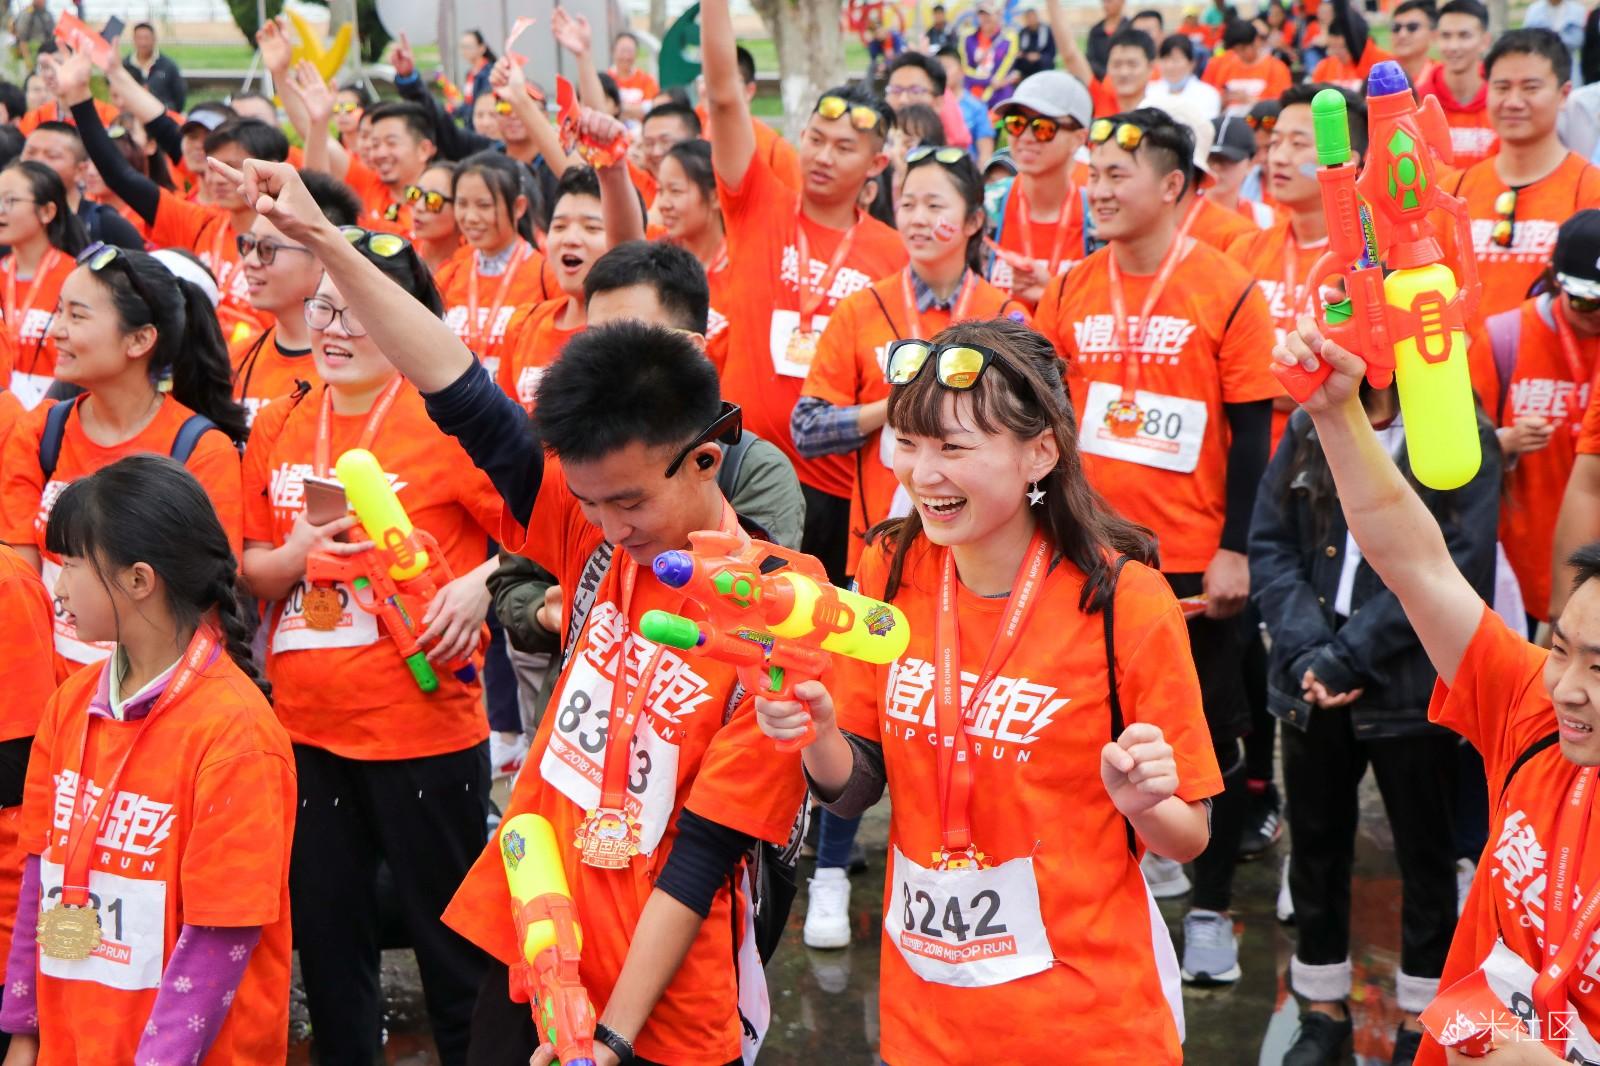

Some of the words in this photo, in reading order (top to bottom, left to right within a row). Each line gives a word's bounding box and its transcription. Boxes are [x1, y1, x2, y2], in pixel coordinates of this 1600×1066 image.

[1144, 408, 1182, 439] 80
[944, 690, 952, 705] 2018
[558, 689, 652, 794] 833
[975, 742, 1031, 763] RUN
[564, 749, 590, 772] 2018
[101, 852, 155, 872] RUN
[1556, 847, 1570, 889] KUNMING
[903, 881, 1008, 942] 8242
[1553, 890, 1563, 912] 2018
[924, 942, 943, 957] 2018
[943, 945, 981, 960] MIPOP
[983, 939, 1013, 955] RUN
